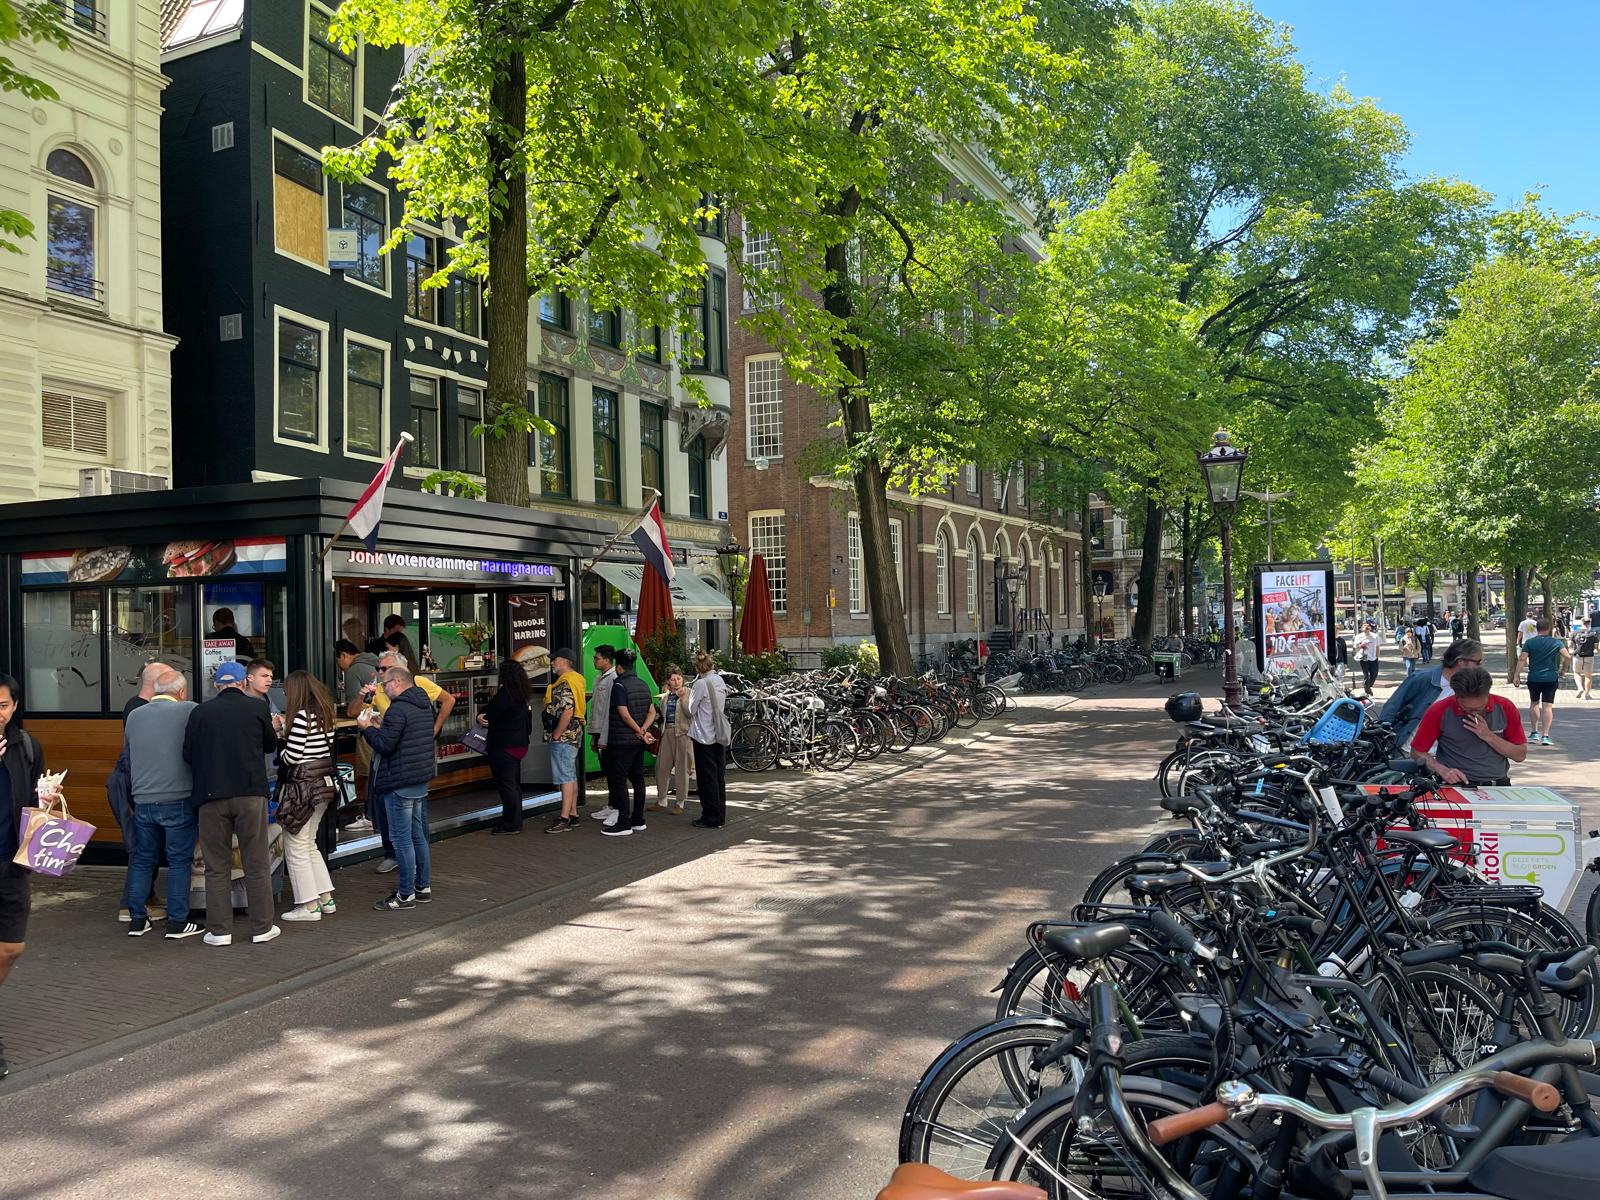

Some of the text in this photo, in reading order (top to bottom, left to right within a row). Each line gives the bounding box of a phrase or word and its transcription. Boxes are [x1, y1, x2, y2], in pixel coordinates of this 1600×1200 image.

[1275, 574, 1311, 586] FACELIFT
[513, 618, 545, 628] BROODJE
[514, 629, 546, 640] HARING
[205, 648, 222, 656] Coffee
[39, 828, 85, 854] Cha
[1479, 832, 1500, 880] tokil
